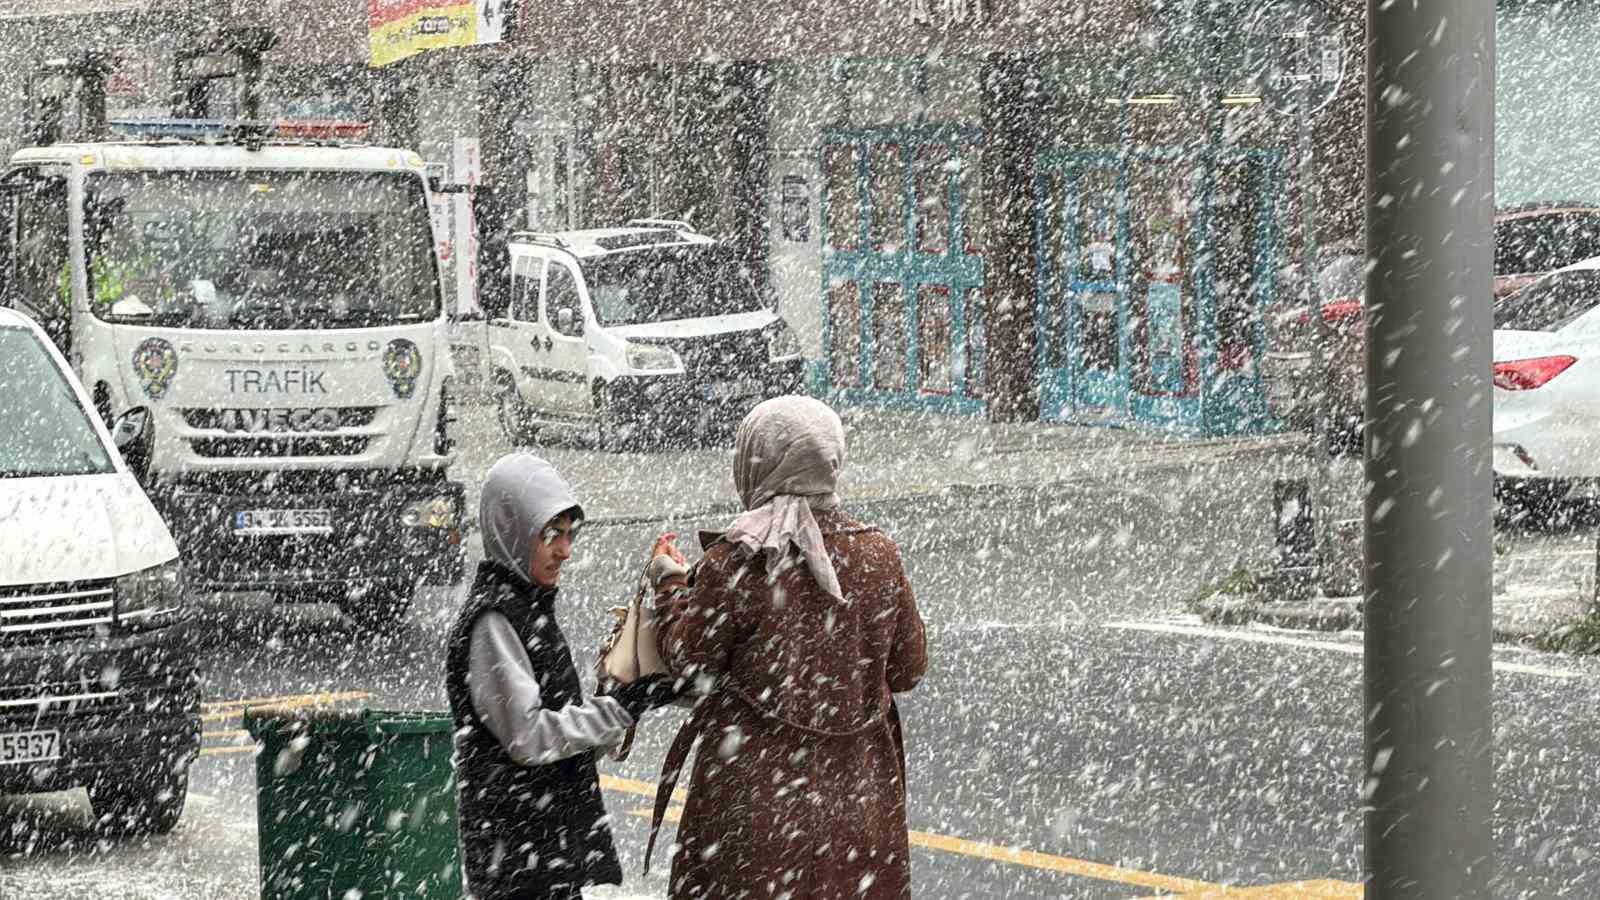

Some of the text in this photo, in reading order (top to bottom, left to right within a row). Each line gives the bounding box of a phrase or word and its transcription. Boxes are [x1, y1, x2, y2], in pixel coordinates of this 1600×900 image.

[225, 365, 328, 394] TRAFİK
[221, 408, 340, 433] IVECO
[3, 733, 56, 760] 5937
